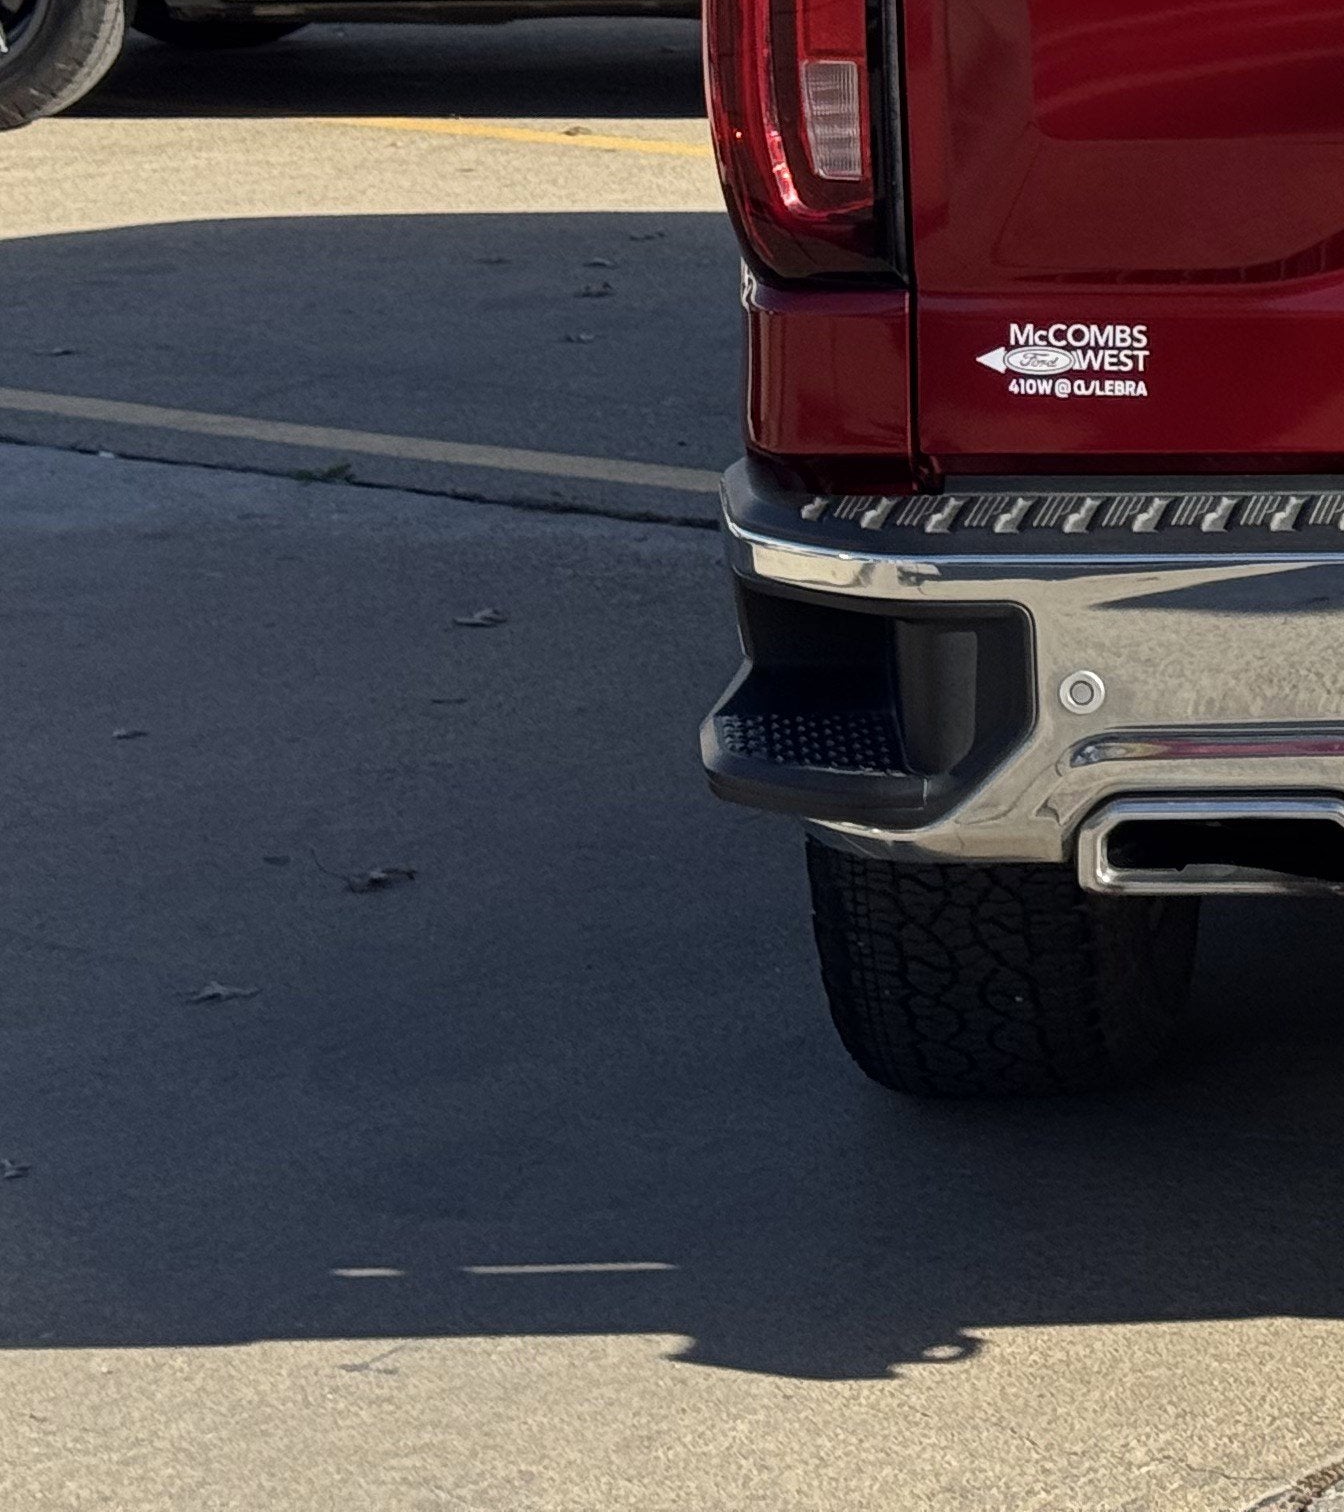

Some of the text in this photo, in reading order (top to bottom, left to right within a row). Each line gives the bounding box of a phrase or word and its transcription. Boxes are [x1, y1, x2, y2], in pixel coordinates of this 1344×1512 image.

[1009, 323, 1149, 348] McCOMBS
[1020, 349, 1151, 372] Ford WEST
